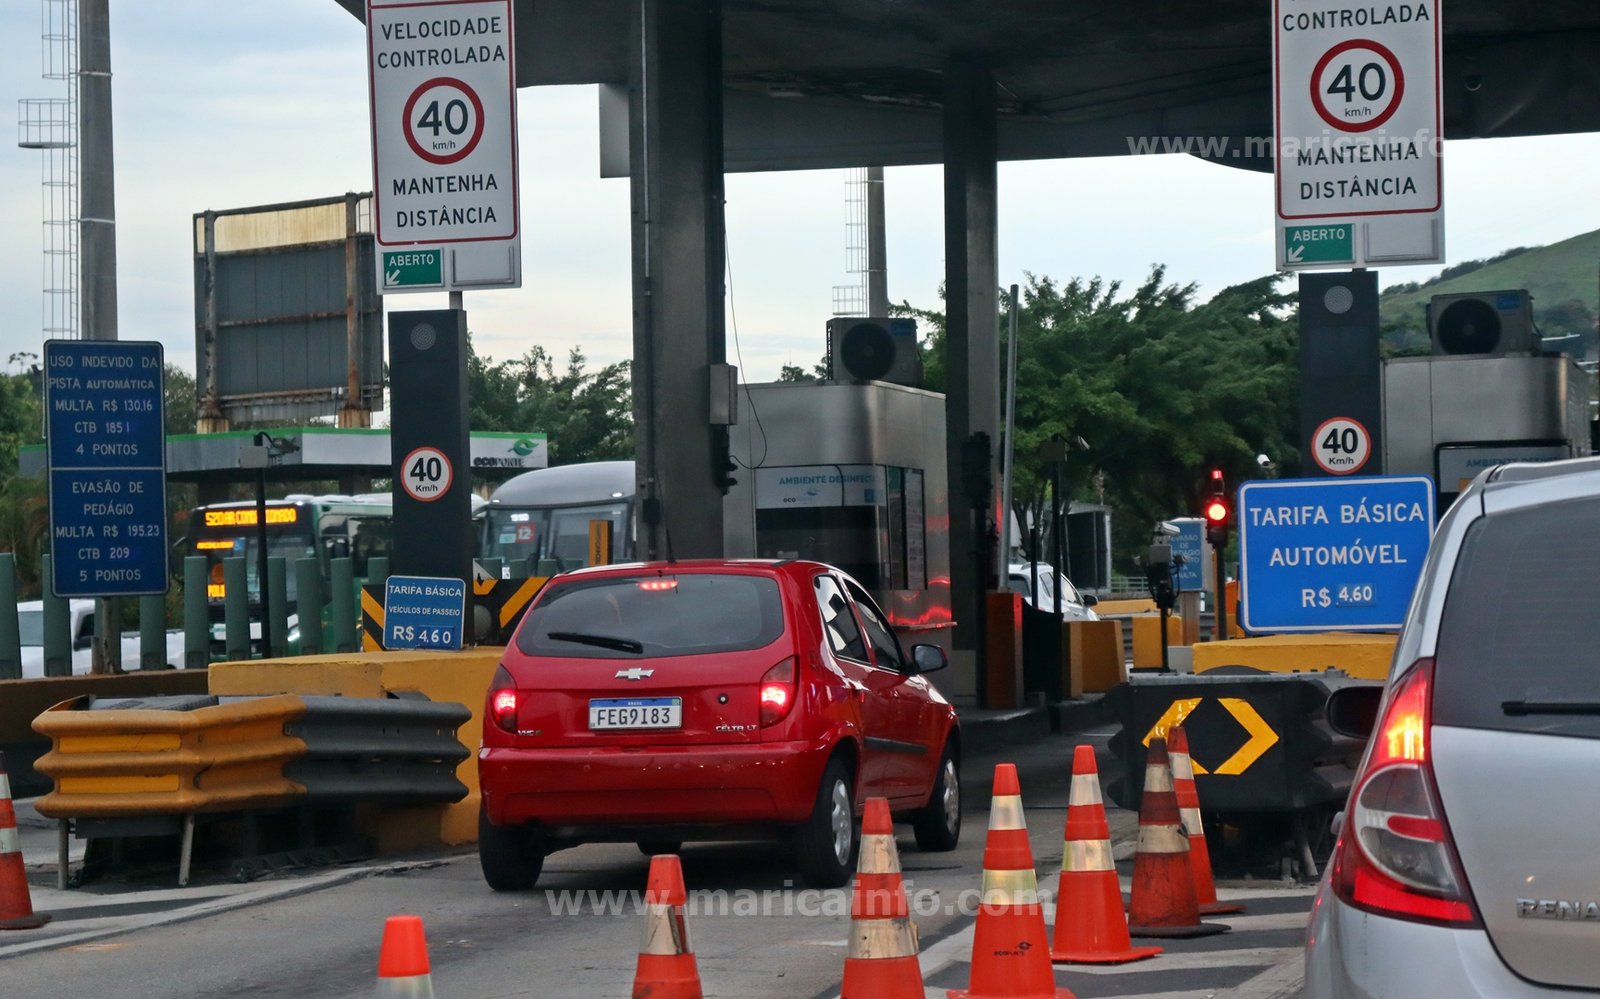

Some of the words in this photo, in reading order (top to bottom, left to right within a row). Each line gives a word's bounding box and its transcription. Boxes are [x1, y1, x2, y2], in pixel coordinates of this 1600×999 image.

[1283, 4, 1430, 31] CONTROLADA
[381, 16, 501, 40] VELOCIDADE
[377, 45, 506, 69] CONTROLADA
[1326, 62, 1386, 102] 40
[417, 99, 468, 136] 40
[1344, 107, 1372, 118] km/h
[432, 141, 456, 150] km/h
[1297, 142, 1419, 166] MANTENHA
[393, 174, 498, 196] MANTENHA
[1300, 176, 1417, 200] DISTÂNCIA
[397, 205, 497, 228] DISTÂNCIA
[1293, 228, 1346, 242] ABERTO
[389, 254, 434, 267] ABERTO
[50, 356, 74, 368] USO
[82, 356, 134, 369] INDEVIDO
[142, 357, 158, 369] DA
[49, 378, 81, 389] PISTA
[86, 379, 154, 390] AUTOMÁTICA
[55, 400, 94, 412] MULTA
[103, 400, 118, 412] R$
[74, 422, 97, 433] CTB
[1322, 428, 1359, 454] 40
[76, 444, 84, 455] 4
[92, 444, 138, 455] PONTOS
[1328, 457, 1354, 465] Km/h
[410, 457, 442, 482] 40
[72, 479, 120, 493] EVASÃO
[129, 482, 144, 493] DE
[779, 475, 827, 485] AMBIENTE
[84, 501, 134, 515] PEDÁGIO
[1250, 505, 1329, 526] TARIFA
[1340, 497, 1425, 524] BÁSICA
[56, 526, 94, 538] MULTA
[103, 525, 119, 538] R$
[78, 548, 100, 559] CTB
[109, 547, 130, 559] 209
[1269, 538, 1407, 567] AUTOMÓVEL
[80, 570, 87, 581] 5
[96, 569, 141, 581] PONTOS
[389, 584, 423, 595] TARIFA
[425, 583, 462, 597] BÁSICA
[1302, 587, 1332, 608] R$
[422, 607, 431, 615] DE
[432, 608, 460, 616] PASSEIO
[393, 626, 414, 641] R$
[596, 708, 670, 726] FEG9I83
